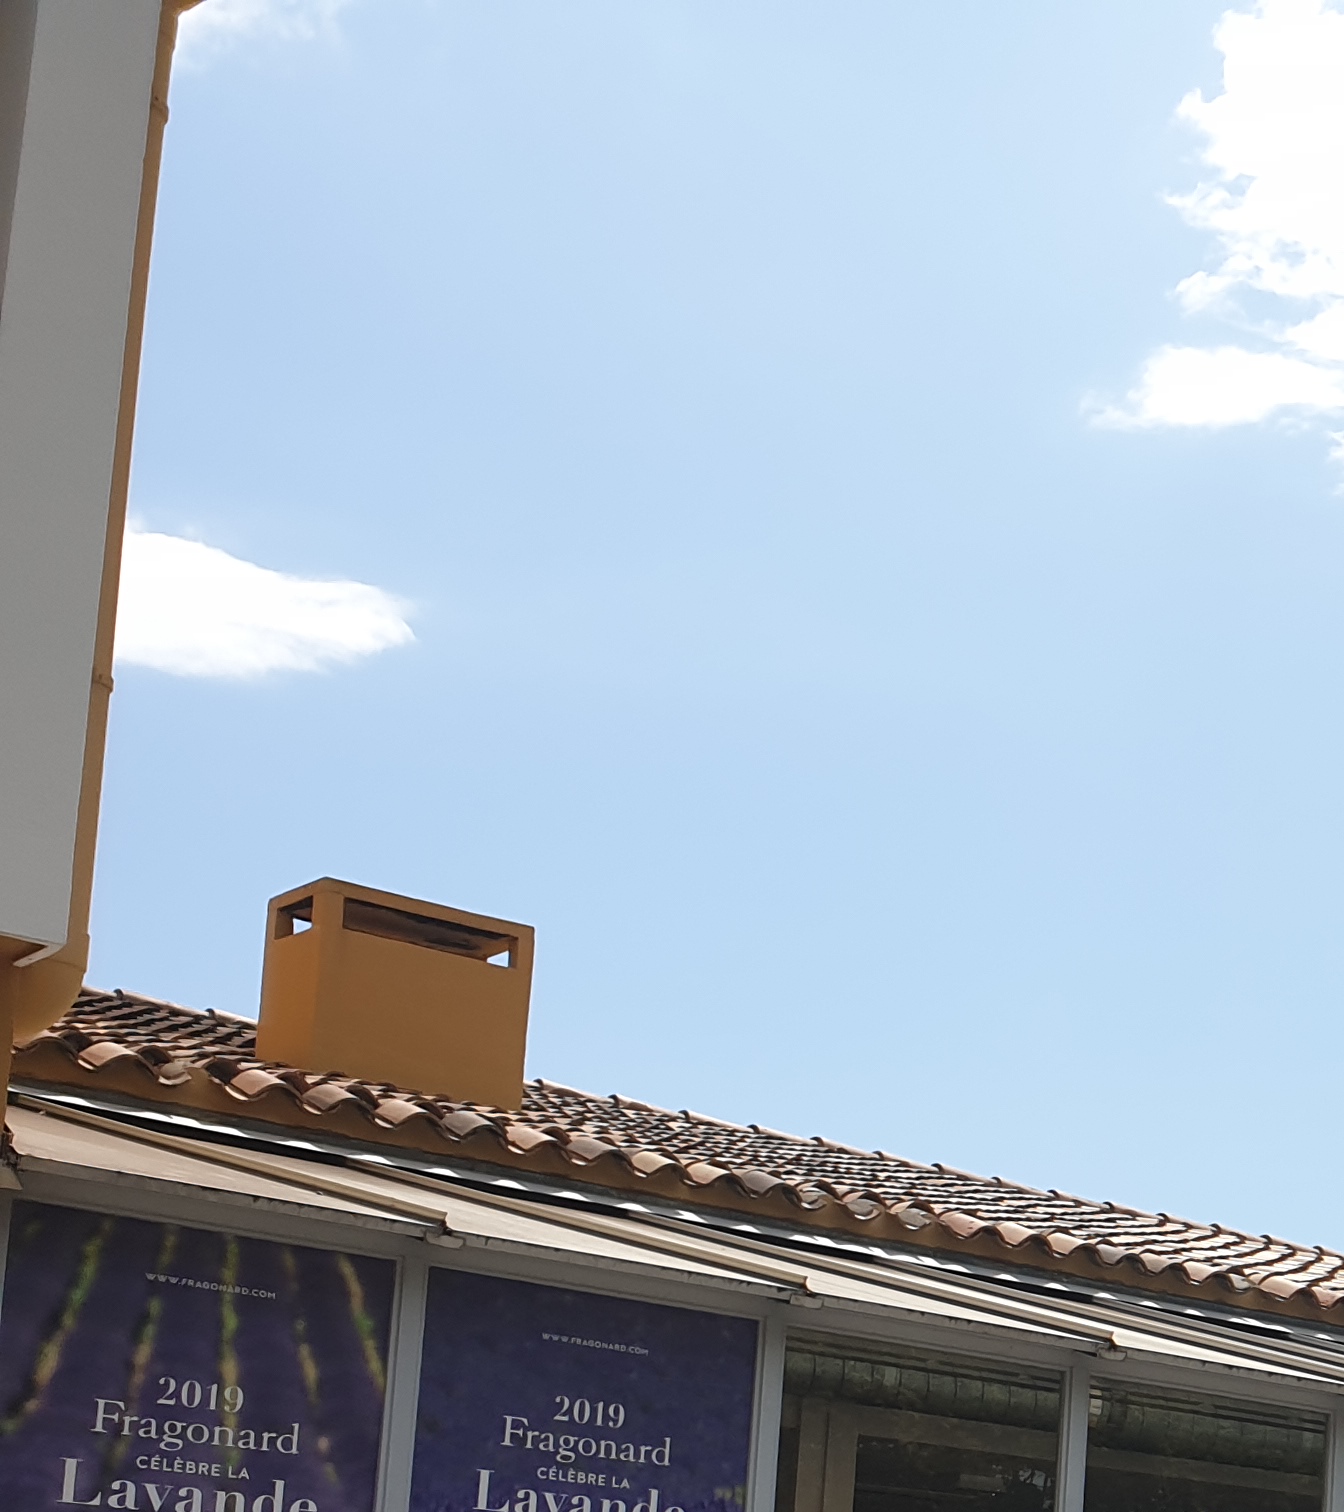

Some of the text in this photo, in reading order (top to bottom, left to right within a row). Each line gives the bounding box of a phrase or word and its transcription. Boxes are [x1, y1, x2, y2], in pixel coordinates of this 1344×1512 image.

[145, 1272, 276, 1300] WWW.FRAGONARD.COM
[156, 1376, 245, 1414] 2019
[553, 1395, 626, 1429] 2019
[89, 1398, 301, 1455] Fragonard
[500, 1415, 672, 1466] Fragonard
[136, 1454, 250, 1480] CÉLÈBRE LA
[537, 1466, 630, 1489] CÉLÈBRE LA
